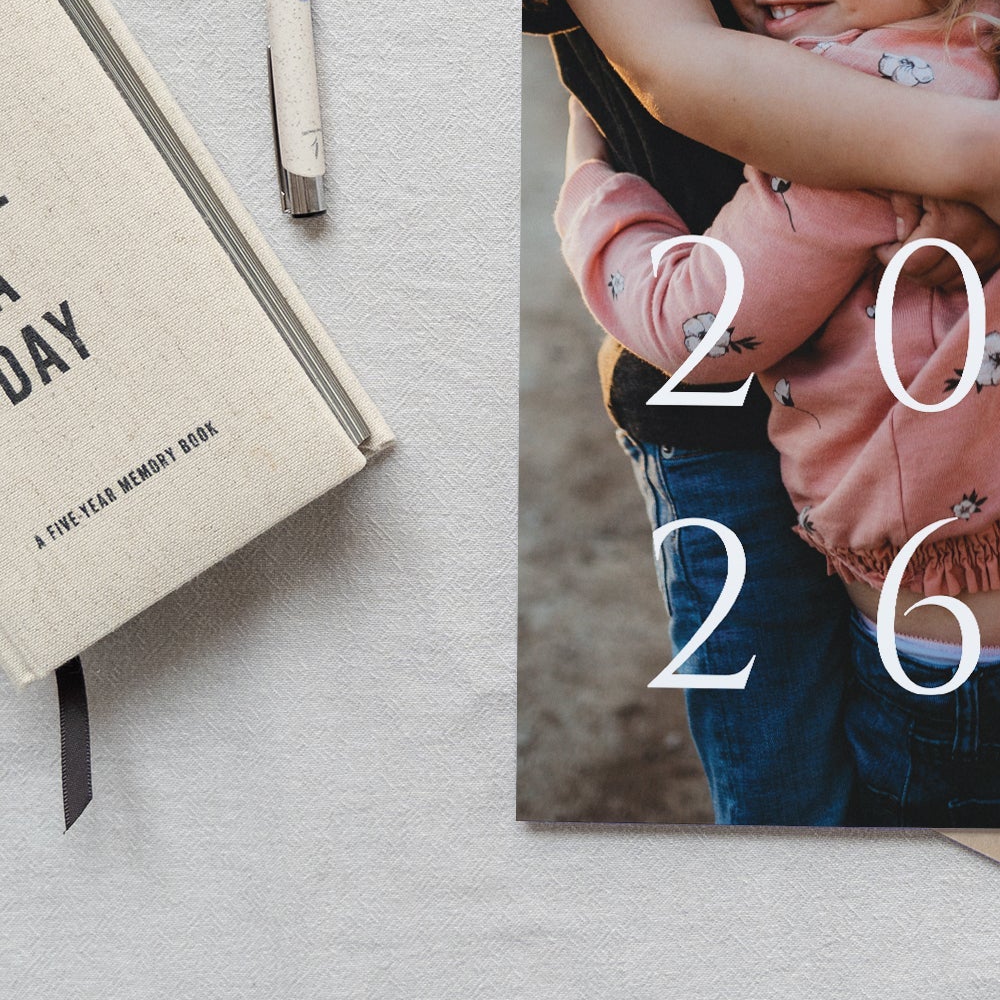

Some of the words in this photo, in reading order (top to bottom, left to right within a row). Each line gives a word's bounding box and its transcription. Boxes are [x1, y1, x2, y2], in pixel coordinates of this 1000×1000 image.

[0, 299, 91, 406] DAY
[34, 534, 47, 550] A
[46, 487, 118, 541] FIVE-YEAR
[117, 447, 177, 494] MEMORY
[177, 420, 219, 454] BOOK
